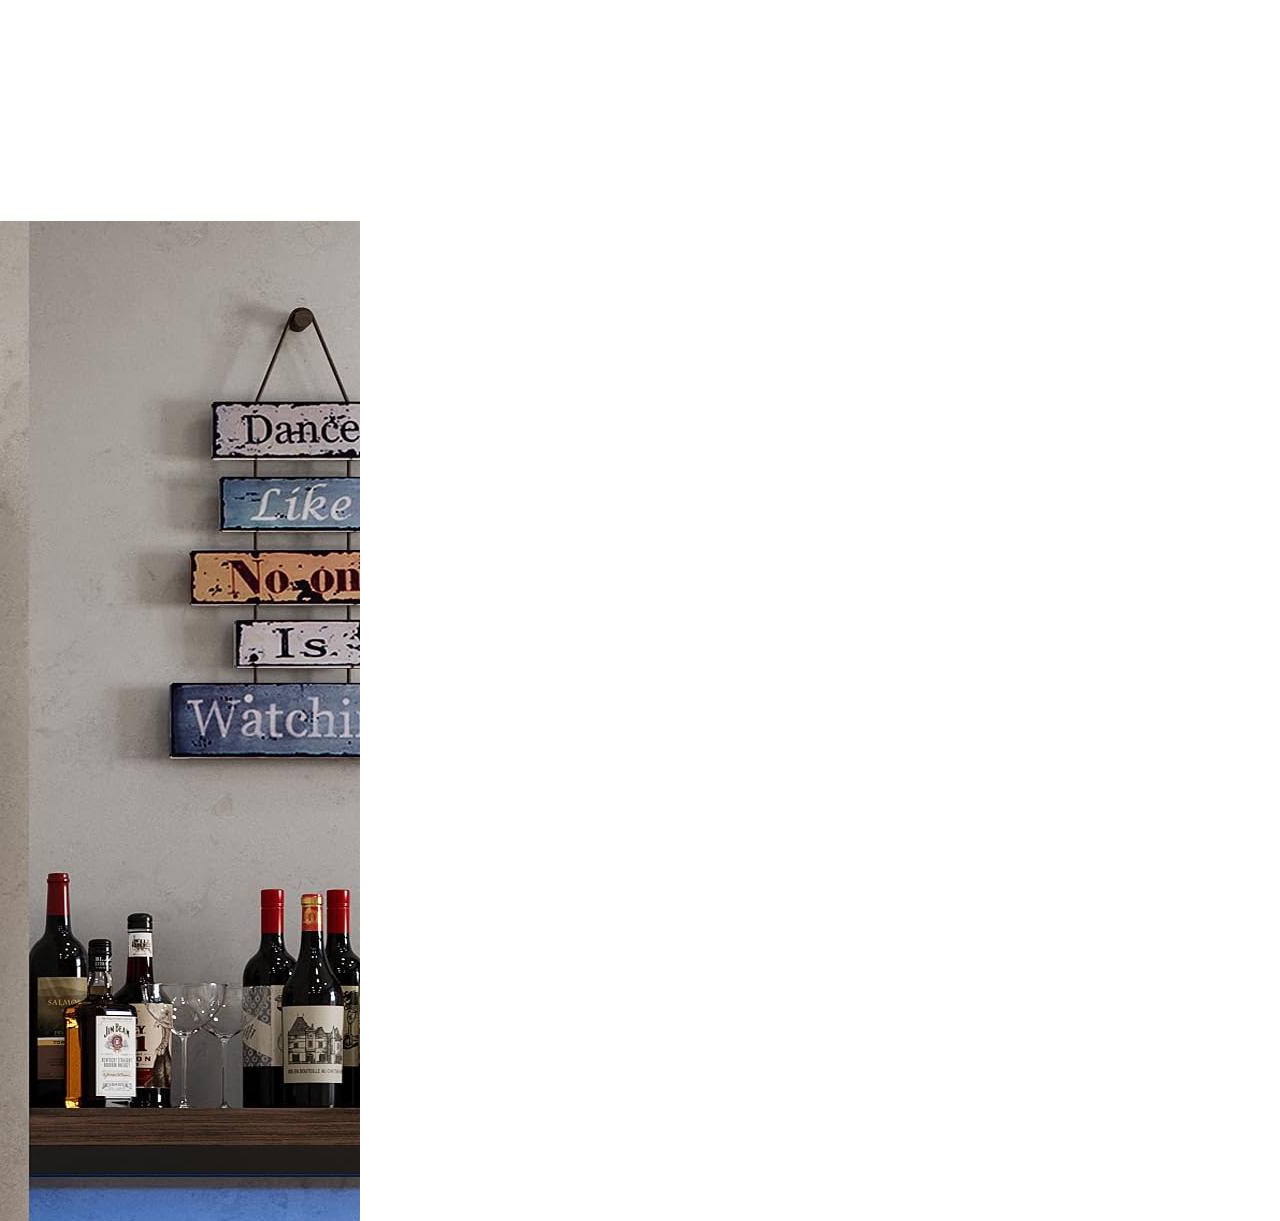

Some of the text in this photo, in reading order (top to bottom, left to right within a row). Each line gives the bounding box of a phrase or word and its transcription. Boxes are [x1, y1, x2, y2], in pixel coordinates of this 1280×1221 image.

[241, 414, 360, 444] Dance
[250, 483, 353, 521] Like
[227, 559, 289, 596] No
[275, 627, 329, 658] Is
[187, 694, 360, 738] Watchi
